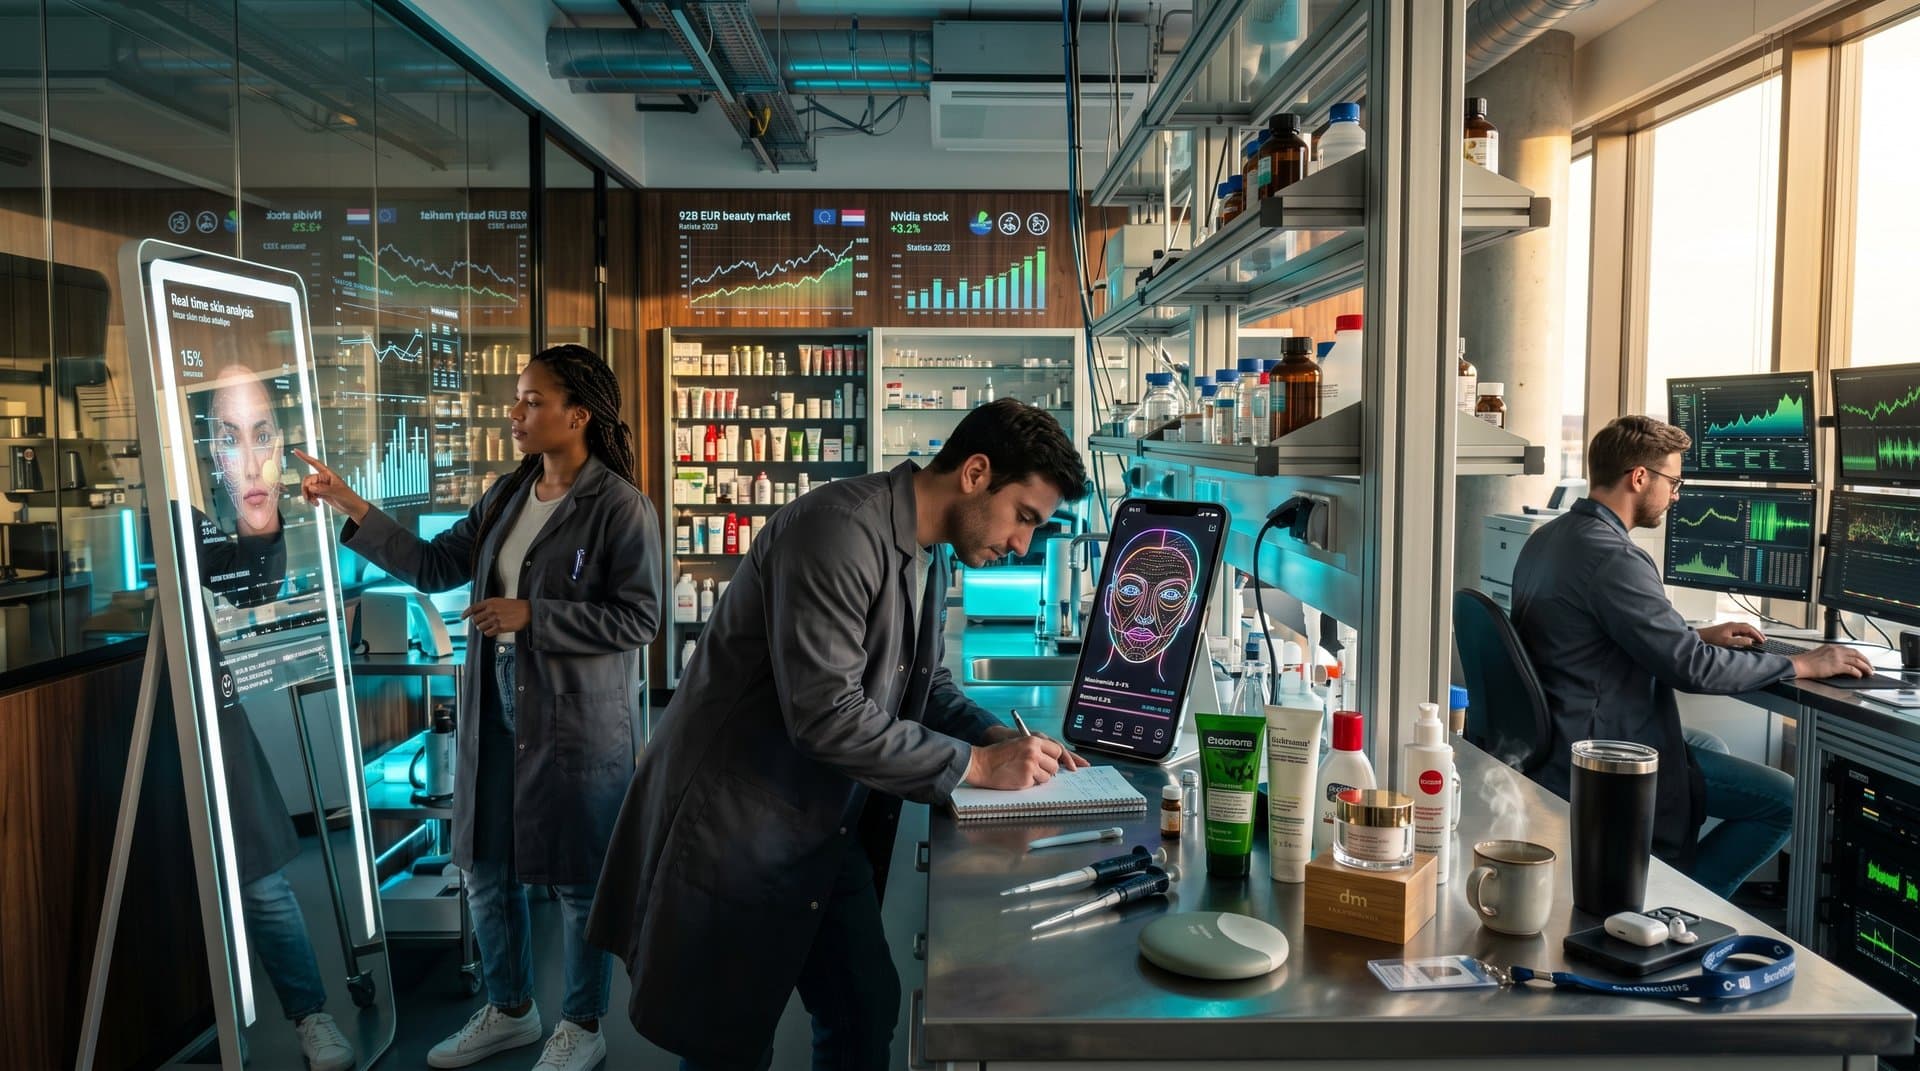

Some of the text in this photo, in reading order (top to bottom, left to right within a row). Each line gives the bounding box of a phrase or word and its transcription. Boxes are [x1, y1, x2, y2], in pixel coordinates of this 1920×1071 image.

[679, 210, 791, 222] 92B EUR beauty market
[890, 211, 949, 222] Nvidia stock
[702, 223, 718, 231] 2023
[890, 224, 921, 234] +3.2%
[906, 244, 951, 252] Statista 2023
[170, 292, 255, 320] Real time skin analysis
[180, 349, 204, 368] 15%
[1339, 888, 1368, 908] dm
